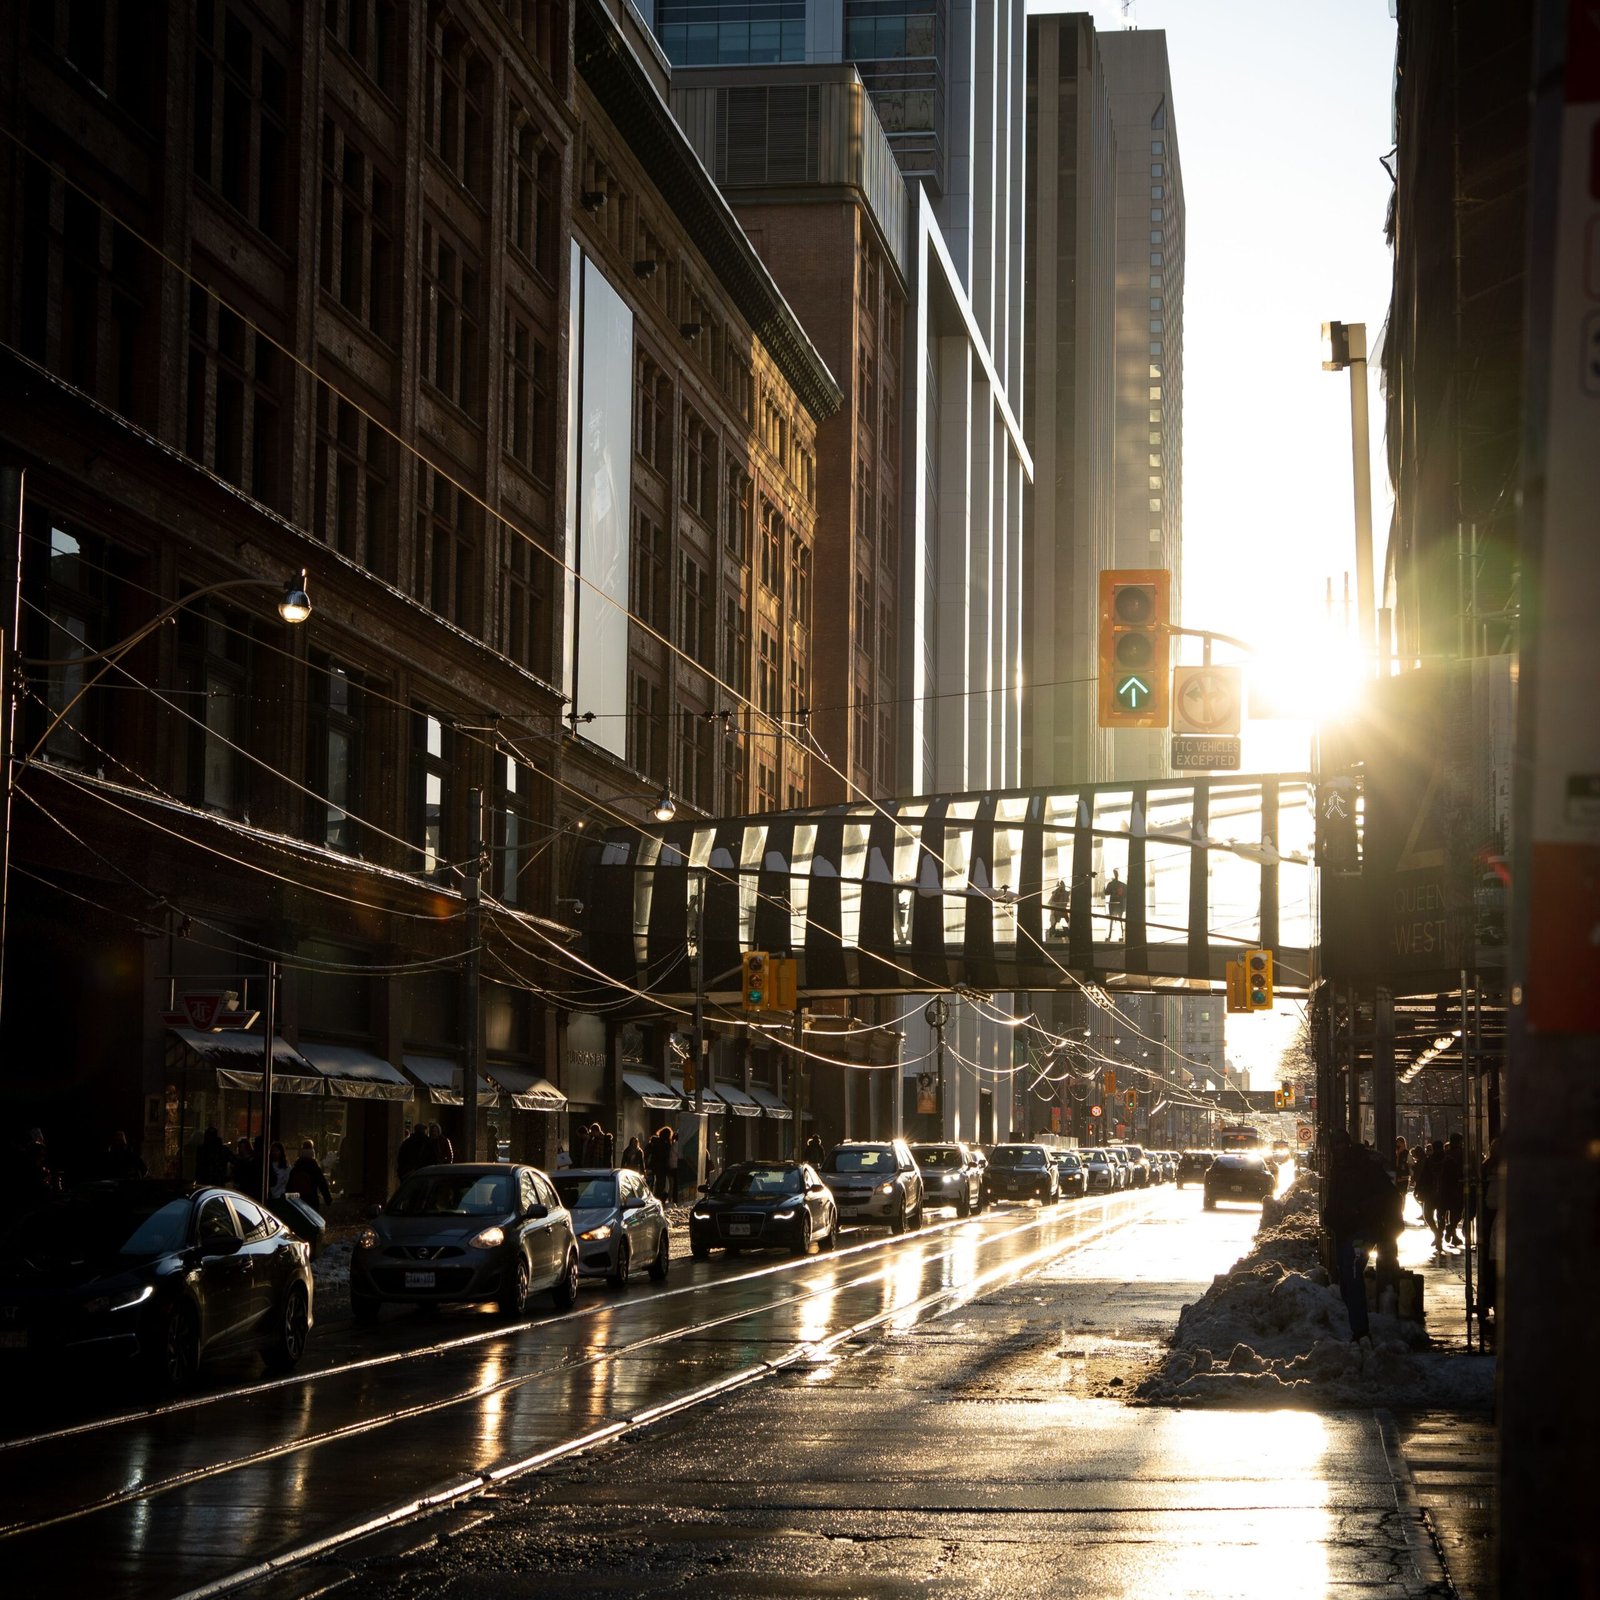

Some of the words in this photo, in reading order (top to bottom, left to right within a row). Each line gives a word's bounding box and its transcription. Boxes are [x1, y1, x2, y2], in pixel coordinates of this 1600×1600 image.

[1174, 741, 1192, 752] TTC
[1196, 741, 1239, 753] VEHICLES
[1176, 754, 1236, 766] EXCEPTED
[1394, 883, 1447, 913] QUEEN
[1394, 920, 1446, 955] WEST
